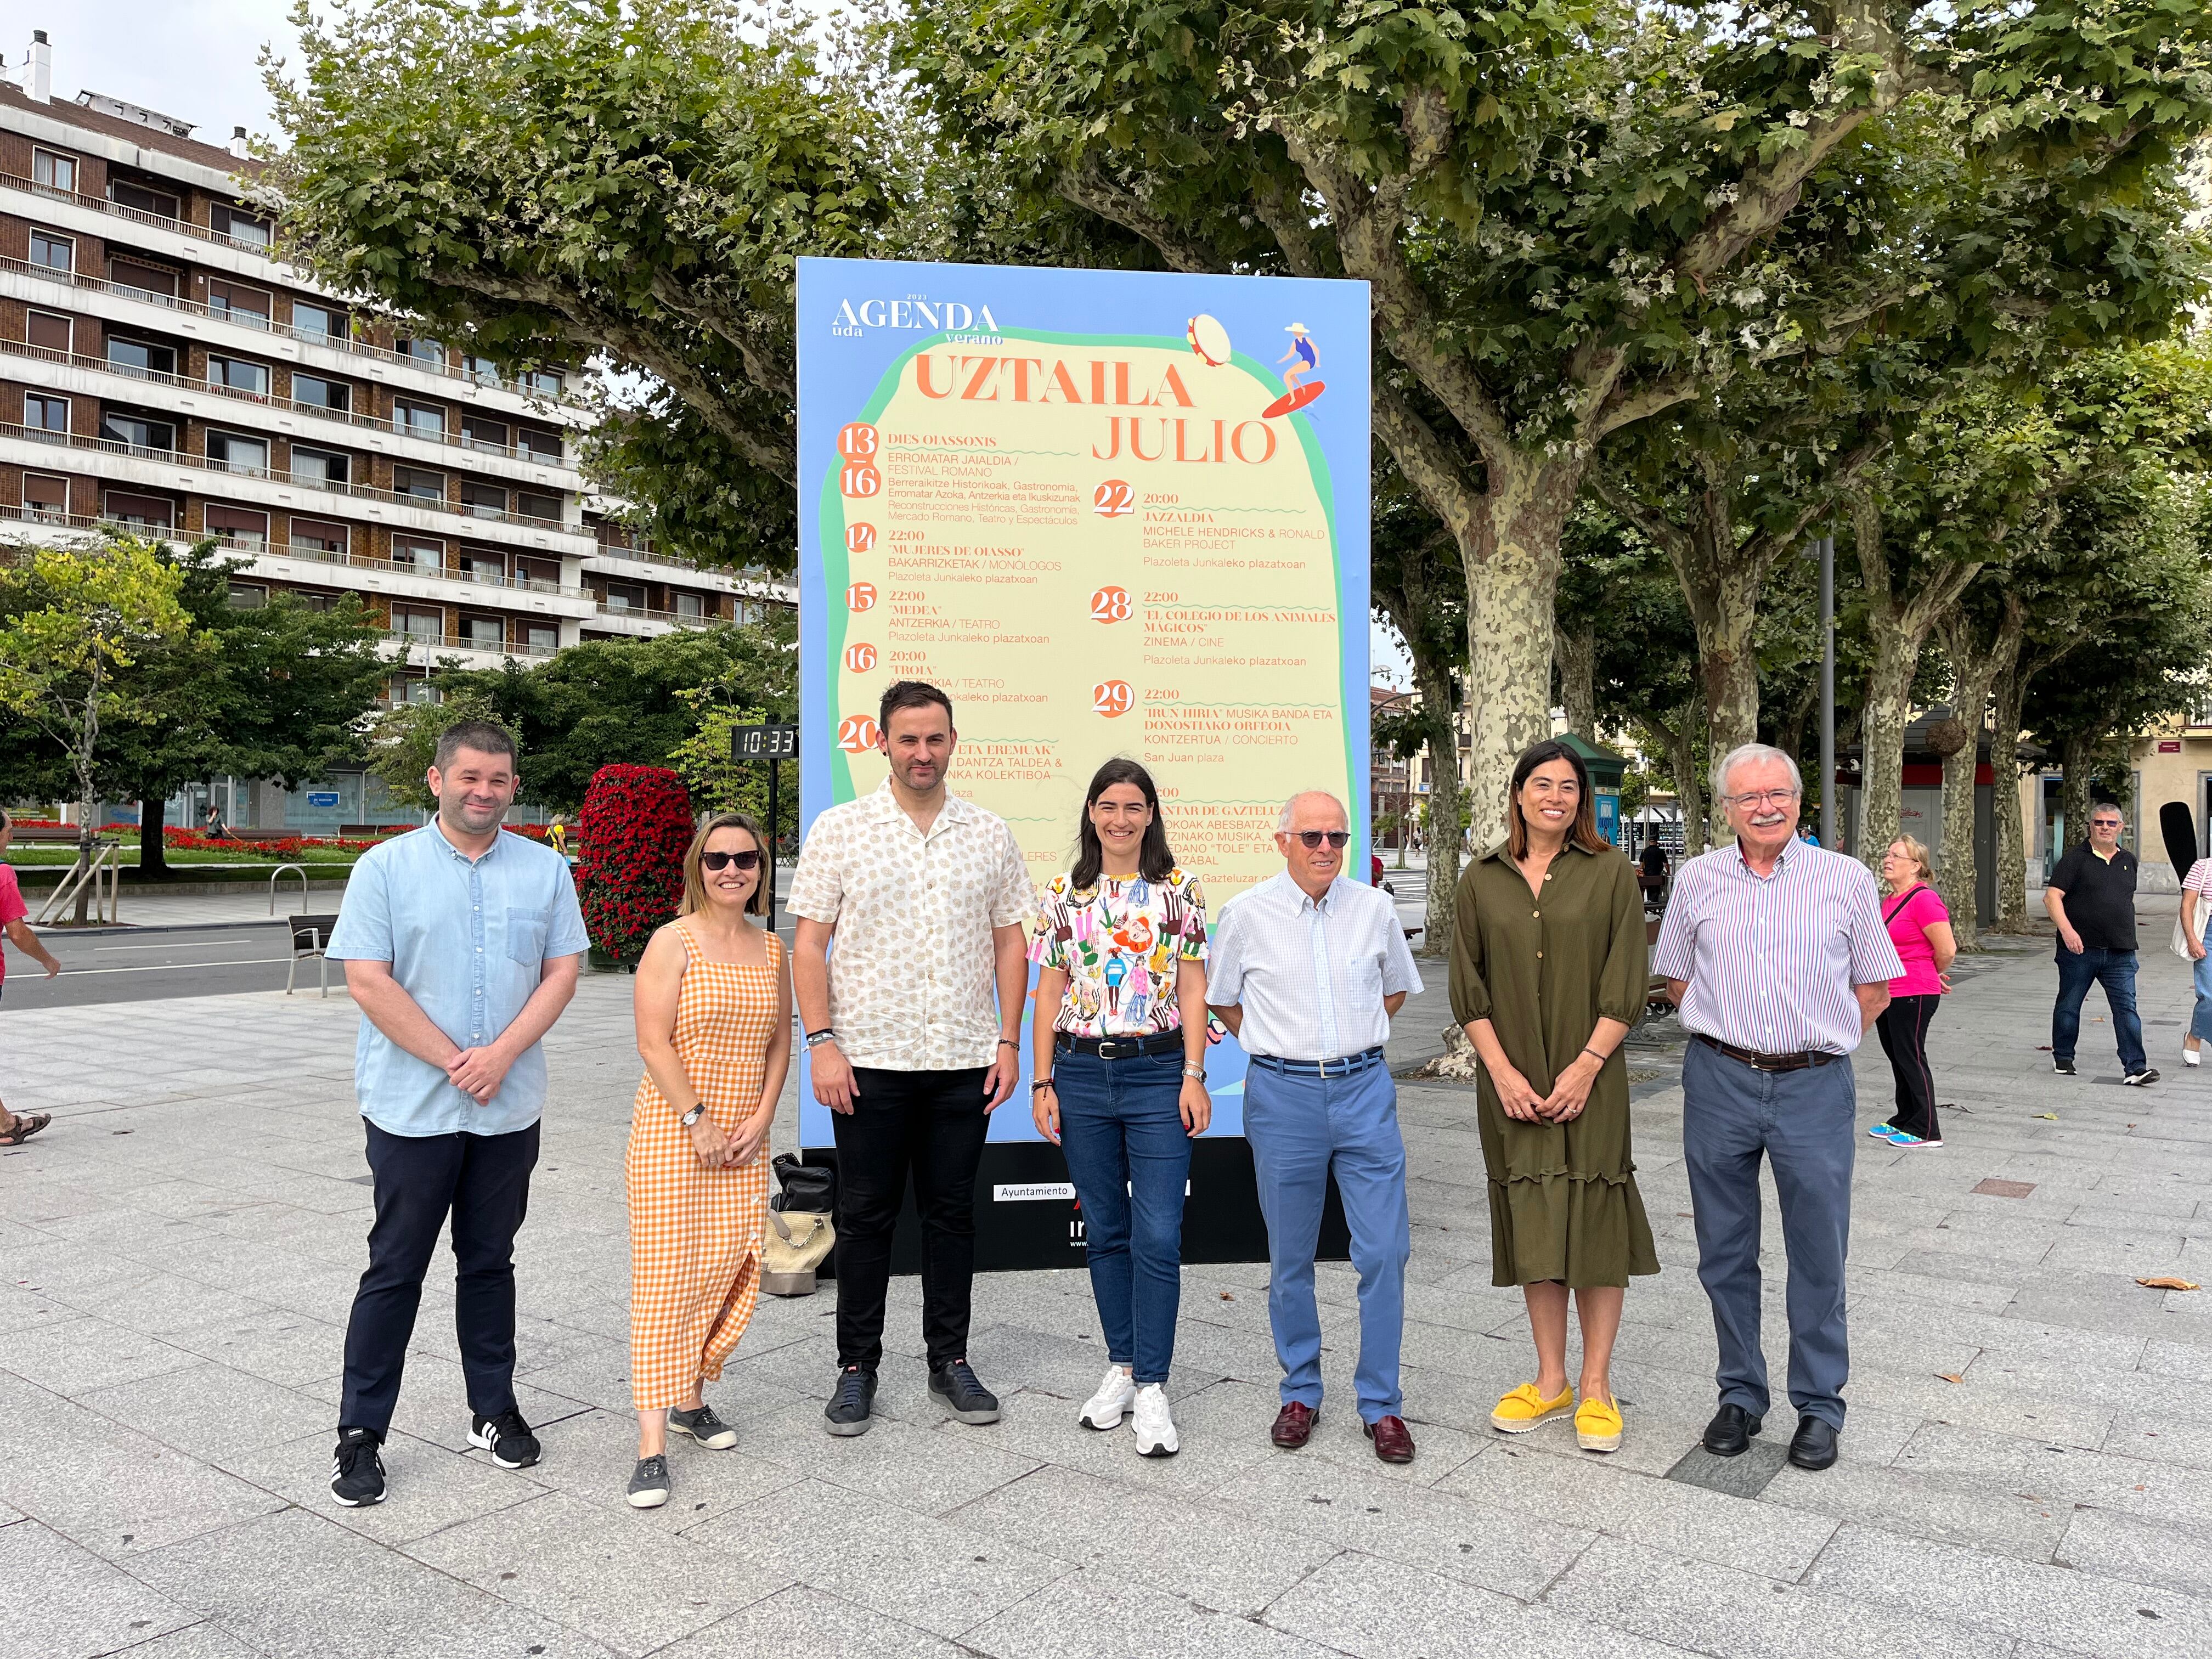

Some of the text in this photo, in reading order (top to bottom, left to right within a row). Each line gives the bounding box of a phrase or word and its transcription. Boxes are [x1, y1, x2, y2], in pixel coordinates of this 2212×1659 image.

[832, 298, 1001, 332] AGENDA
[832, 326, 864, 337] uda
[946, 333, 1003, 345] verano
[915, 354, 1197, 408] UZTAILA
[843, 427, 875, 454] 13
[888, 433, 996, 447] DIES OIASSONIS
[1092, 416, 1277, 464] JULIO
[888, 453, 958, 464] ERROMATAR
[962, 455, 1011, 466] JAIALDIA
[888, 465, 992, 477] FESTIVAL ROMANO
[844, 468, 876, 495] 16
[888, 478, 949, 488] Berreraikitze
[952, 479, 1010, 490] Historikoak,
[888, 489, 1080, 502] Erromatar Azoka, Antzerkia eta Ikuskizunak
[1093, 484, 1134, 514] 22
[1143, 493, 1178, 504] 20:00
[888, 500, 969, 511] Reconstrucciones
[972, 502, 1018, 514] Históricas,
[888, 511, 1077, 526] Mercado Romano, Teatro y Espectáculos
[1143, 512, 1214, 523] JAZZALDIA
[847, 526, 876, 549] 14
[888, 530, 924, 541] 22:00
[1143, 527, 1324, 539] MICHELE HENDRICKS & RONALD
[1143, 539, 1235, 549] BAKER PROJECT
[888, 545, 1024, 557] "MUJERES DE OIASSO"
[889, 558, 979, 569] BAKARRIZKETAK
[990, 558, 1062, 571] MONÓLOGOS
[1143, 557, 1306, 569] Plazoleta Junkaleko plazatxoan
[889, 572, 1037, 584] Plazoleta Junkaleko plazatxoan
[847, 586, 874, 610] 15
[889, 590, 925, 601] 22:00
[1144, 592, 1178, 602] 22:00
[889, 605, 941, 614] "MEDEA"
[1090, 591, 1133, 620] 28
[1144, 611, 1335, 623] "EL COLEGIO DE LOS ANIMALES
[889, 618, 950, 628] ANTZERKIA
[959, 619, 1000, 629] TEATRO
[1144, 622, 1207, 633] MÁGICOS"
[889, 631, 1049, 644] Plazoleta Junkaleko plazatxoan
[1144, 637, 1187, 646] ZINEMA
[1199, 637, 1224, 647] CINE
[848, 647, 876, 670] 16
[889, 651, 926, 661] 20:00
[1144, 654, 1306, 667] Plazoleta Junkaleko plazatxoan
[889, 665, 936, 675] "TROIA"
[962, 679, 1004, 689] TEATRO
[993, 693, 1048, 703] plazatxoan
[1091, 684, 1133, 712] 29
[1144, 689, 1179, 699] 22:00
[1144, 708, 1332, 719] "IRUN HIRIA" MUSIKA BANDA ETA
[1144, 721, 1290, 731] DONOSTIAKO ORFEOIA
[837, 720, 880, 749] 20
[1144, 735, 1221, 744] KONTZERTUA
[1233, 735, 1297, 745] CONCIERTO
[744, 731, 794, 753] 10:33
[959, 745, 1056, 755] ETA EREMUAK"
[957, 758, 1004, 767] DANTZA
[1008, 758, 1051, 768] TALDEA
[1055, 758, 1062, 768] &
[1144, 753, 1224, 764] San Juan plaza
[977, 770, 1050, 780] KOLEKTIBOA
[952, 789, 973, 797] laza
[1203, 806, 1220, 816] DE
[1207, 821, 1273, 830] ABESBATZA,
[1217, 832, 1264, 842] MUSIKA,
[1254, 844, 1273, 853] ETA
[1203, 874, 1259, 883] Gazteluzar
[1001, 1187, 1068, 1198] Ayuntamiento
